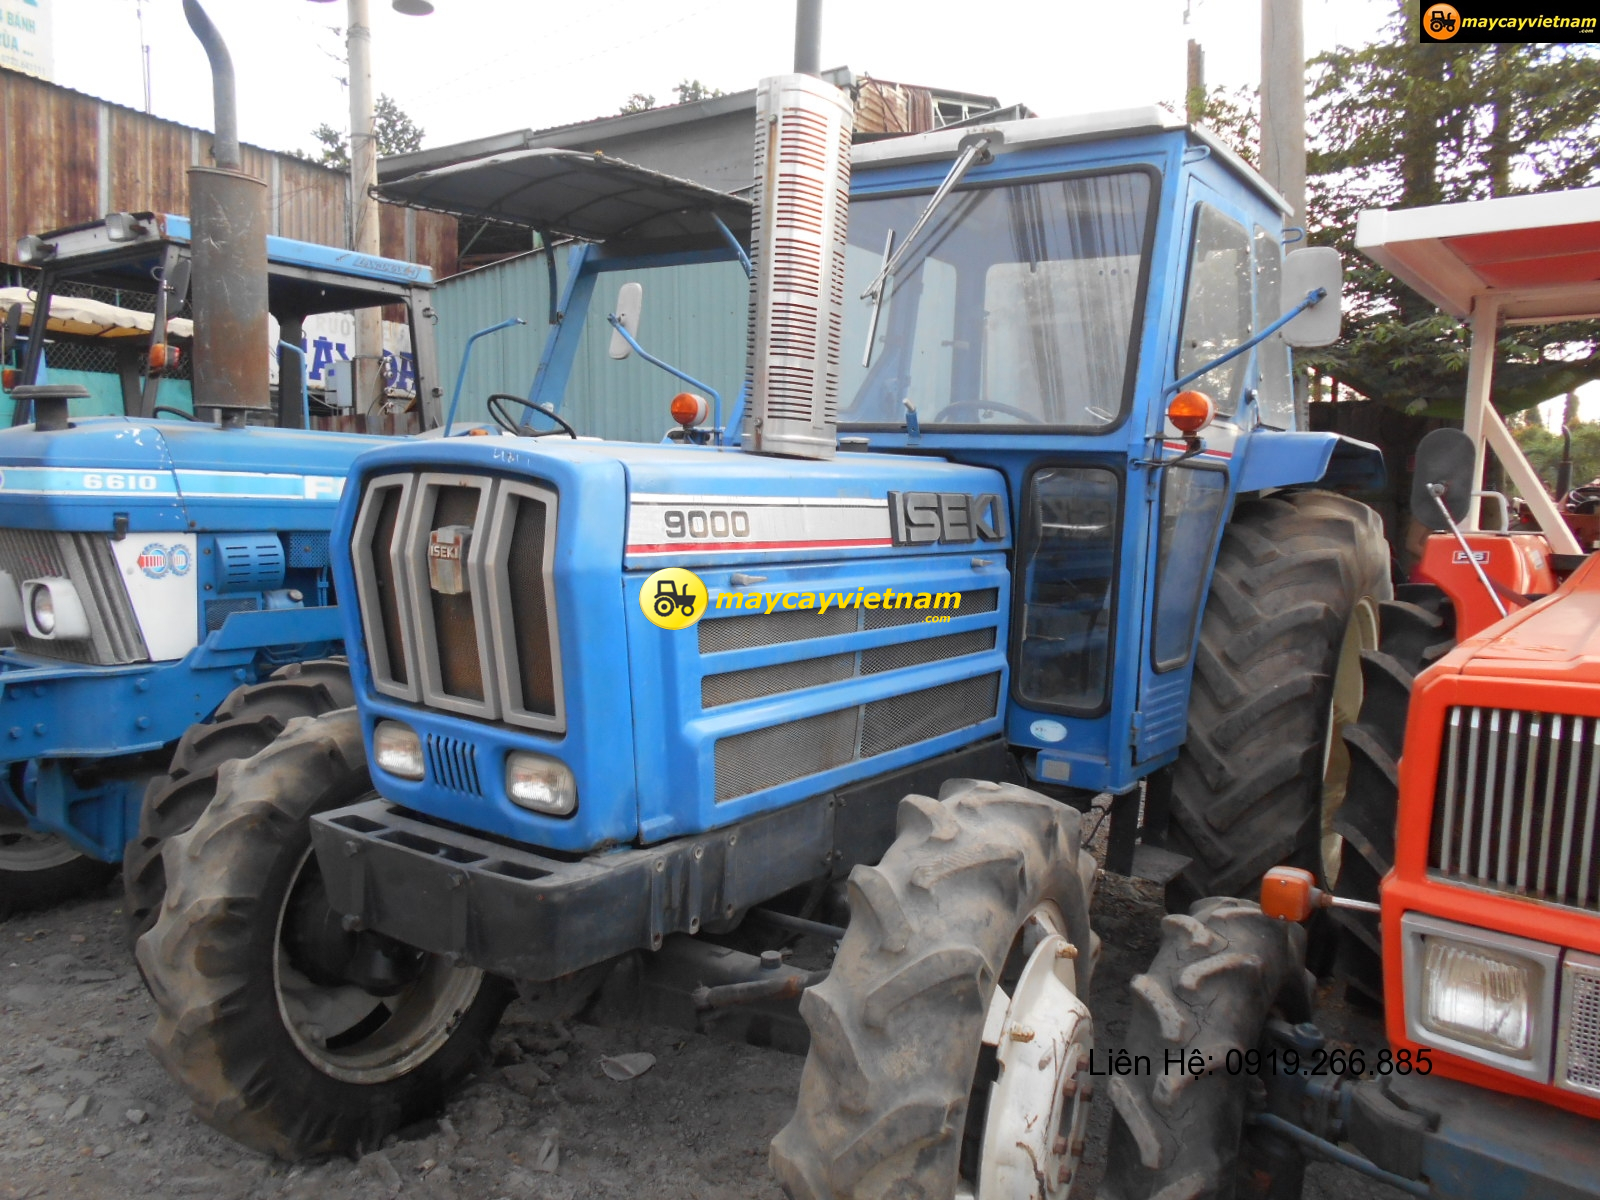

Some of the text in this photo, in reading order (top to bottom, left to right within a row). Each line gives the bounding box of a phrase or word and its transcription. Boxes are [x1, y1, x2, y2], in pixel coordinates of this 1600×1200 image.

[83, 474, 157, 490] 6610
[664, 510, 750, 538] 9000
[888, 491, 1006, 547] ISEKI
[430, 545, 459, 559] ISEKI
